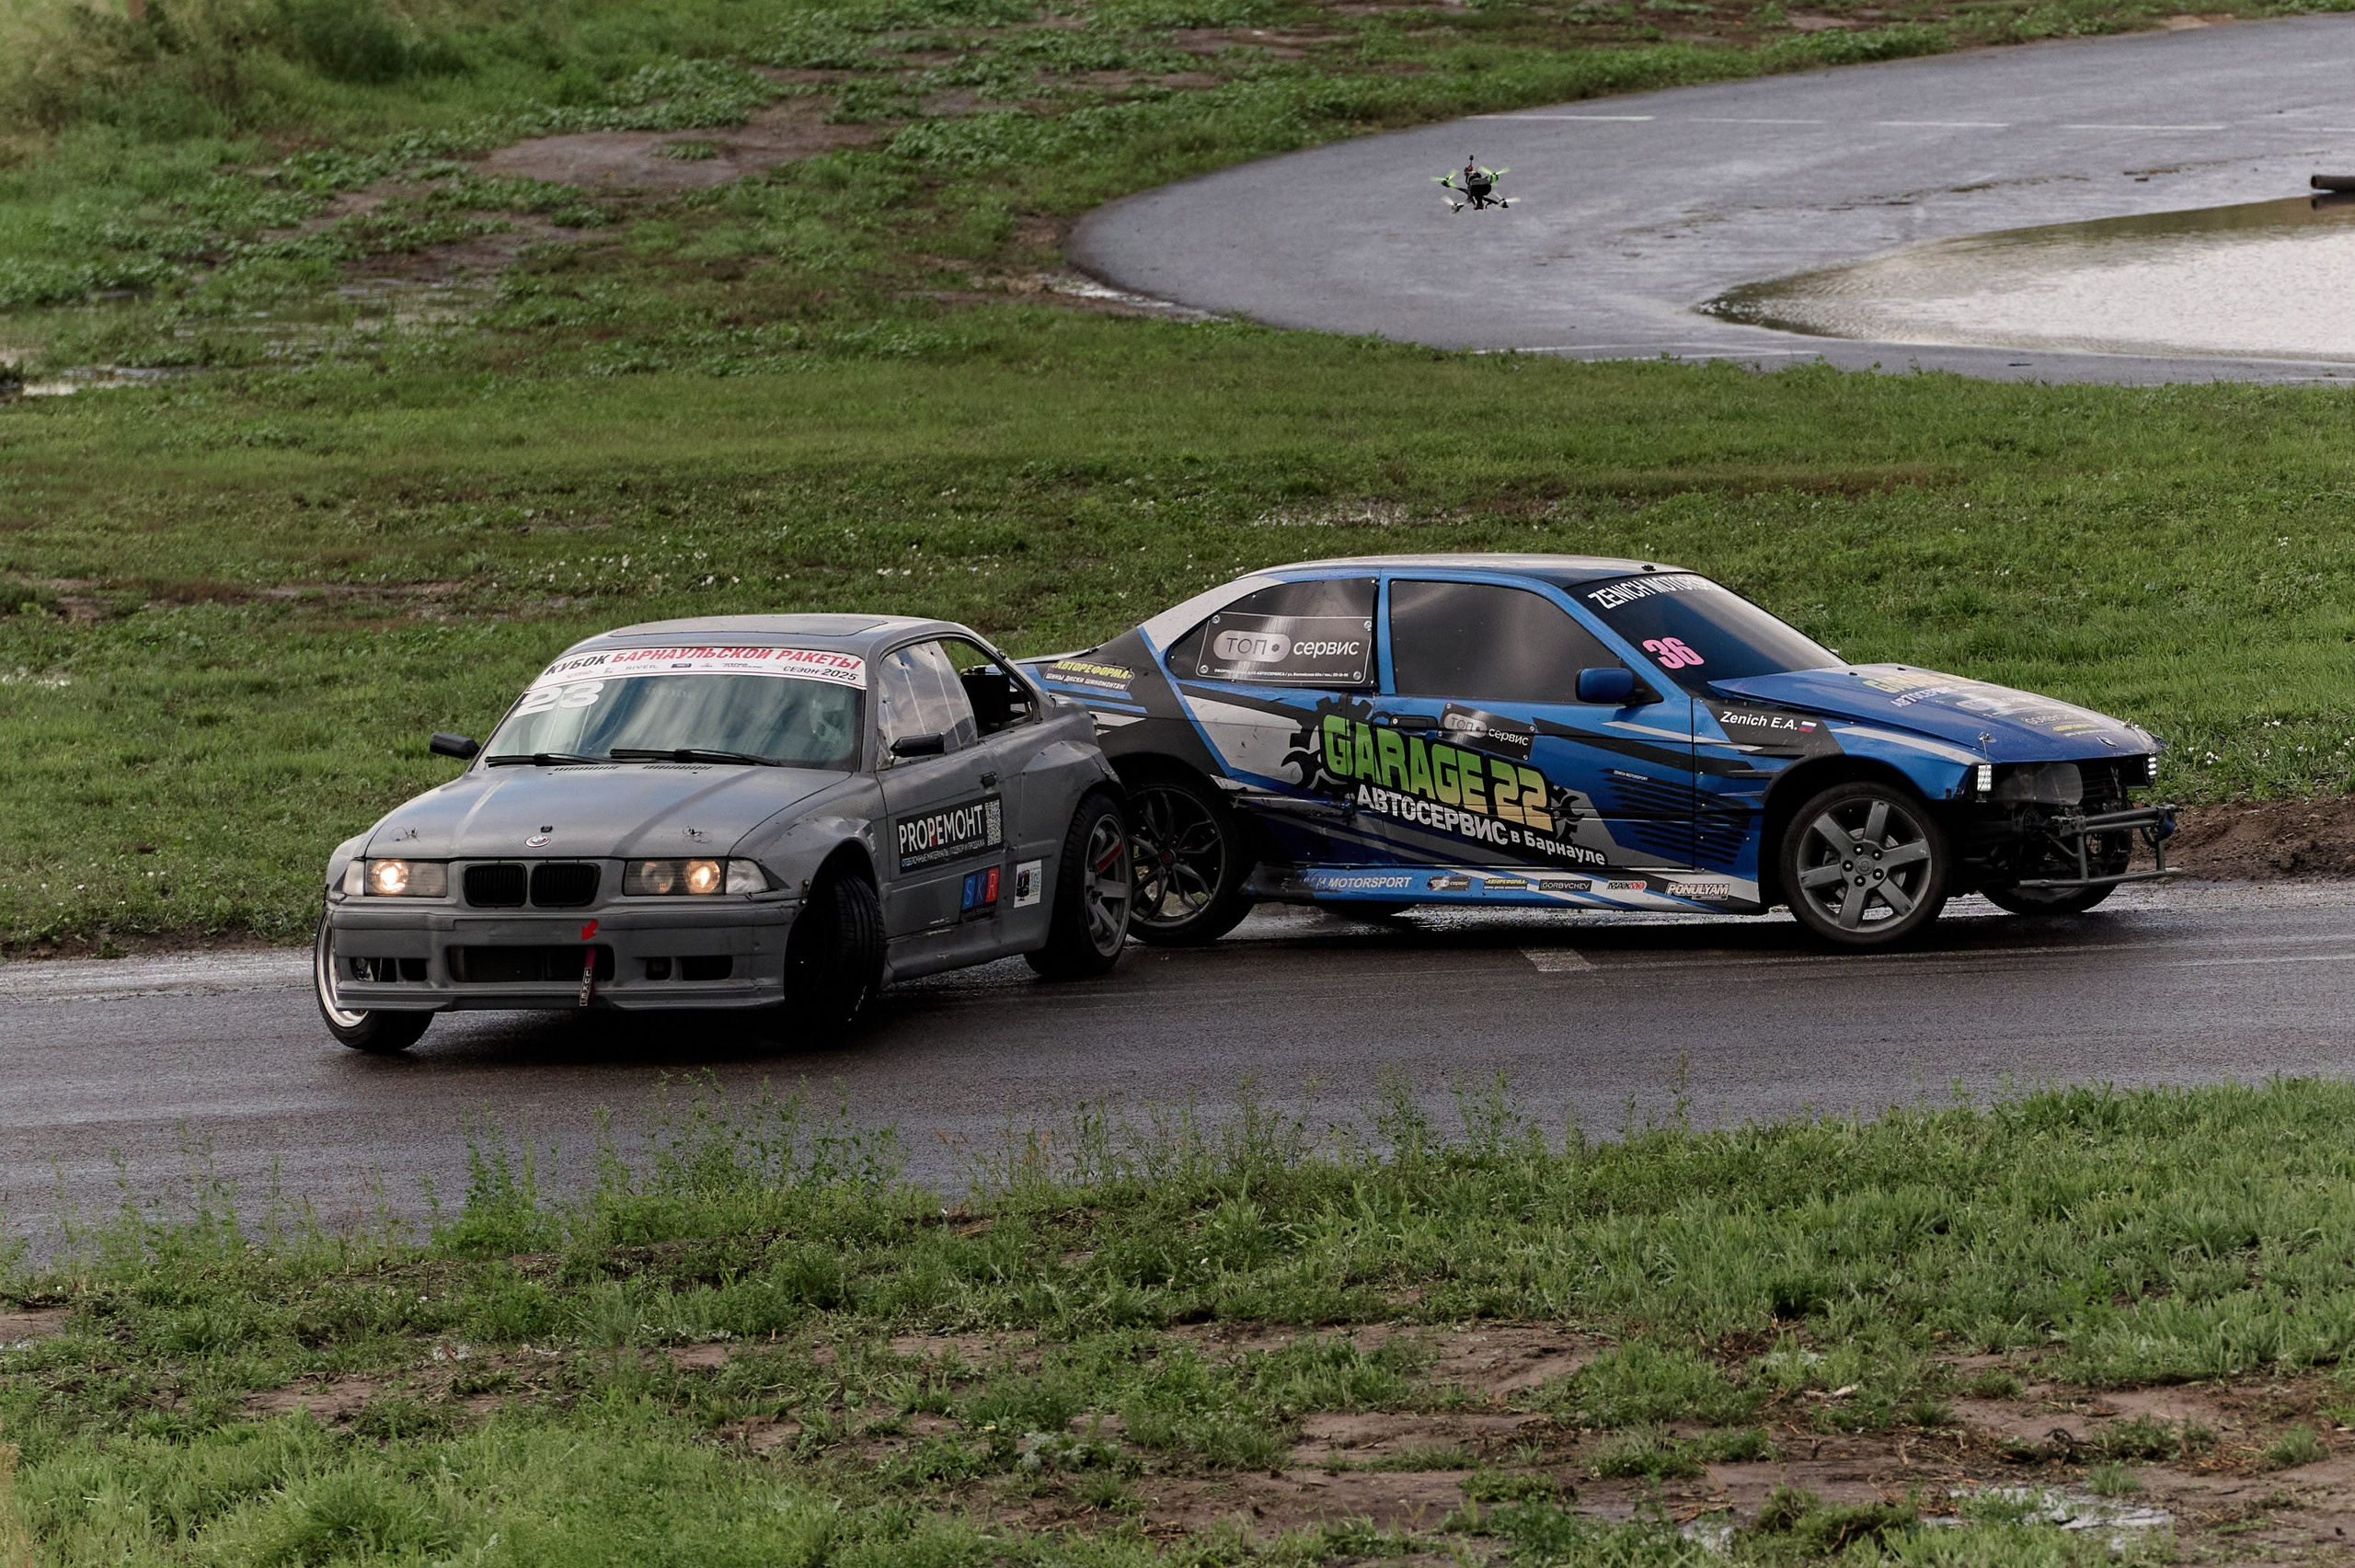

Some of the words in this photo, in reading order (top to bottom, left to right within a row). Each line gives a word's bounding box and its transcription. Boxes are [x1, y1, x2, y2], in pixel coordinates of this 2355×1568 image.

[1587, 579, 1656, 609] ZENICH
[545, 654, 610, 676] КУБОК
[611, 647, 774, 663] БАРНАУЛЬСКОЙ
[775, 649, 862, 670] РАКЕТЫ
[1226, 637, 1268, 655] ТОП
[1293, 641, 1360, 658] сервис
[1642, 637, 1705, 669] 36
[783, 665, 820, 675] СЕЗОН
[821, 668, 858, 681] 2025
[513, 681, 605, 717] 23
[1452, 717, 1474, 732] ТОП
[1488, 728, 1529, 746] сервис
[1720, 711, 1767, 727] Zenich
[1771, 716, 1798, 731] E.A.
[1323, 714, 1488, 816] GARAGE
[1489, 758, 1553, 832] 22
[1357, 784, 1510, 845] АВТОСЕРВИС
[1511, 830, 1521, 843] в
[1523, 831, 1606, 865] Барнауле
[964, 873, 996, 905] SKR
[1328, 876, 1412, 888] MOTORSPORT
